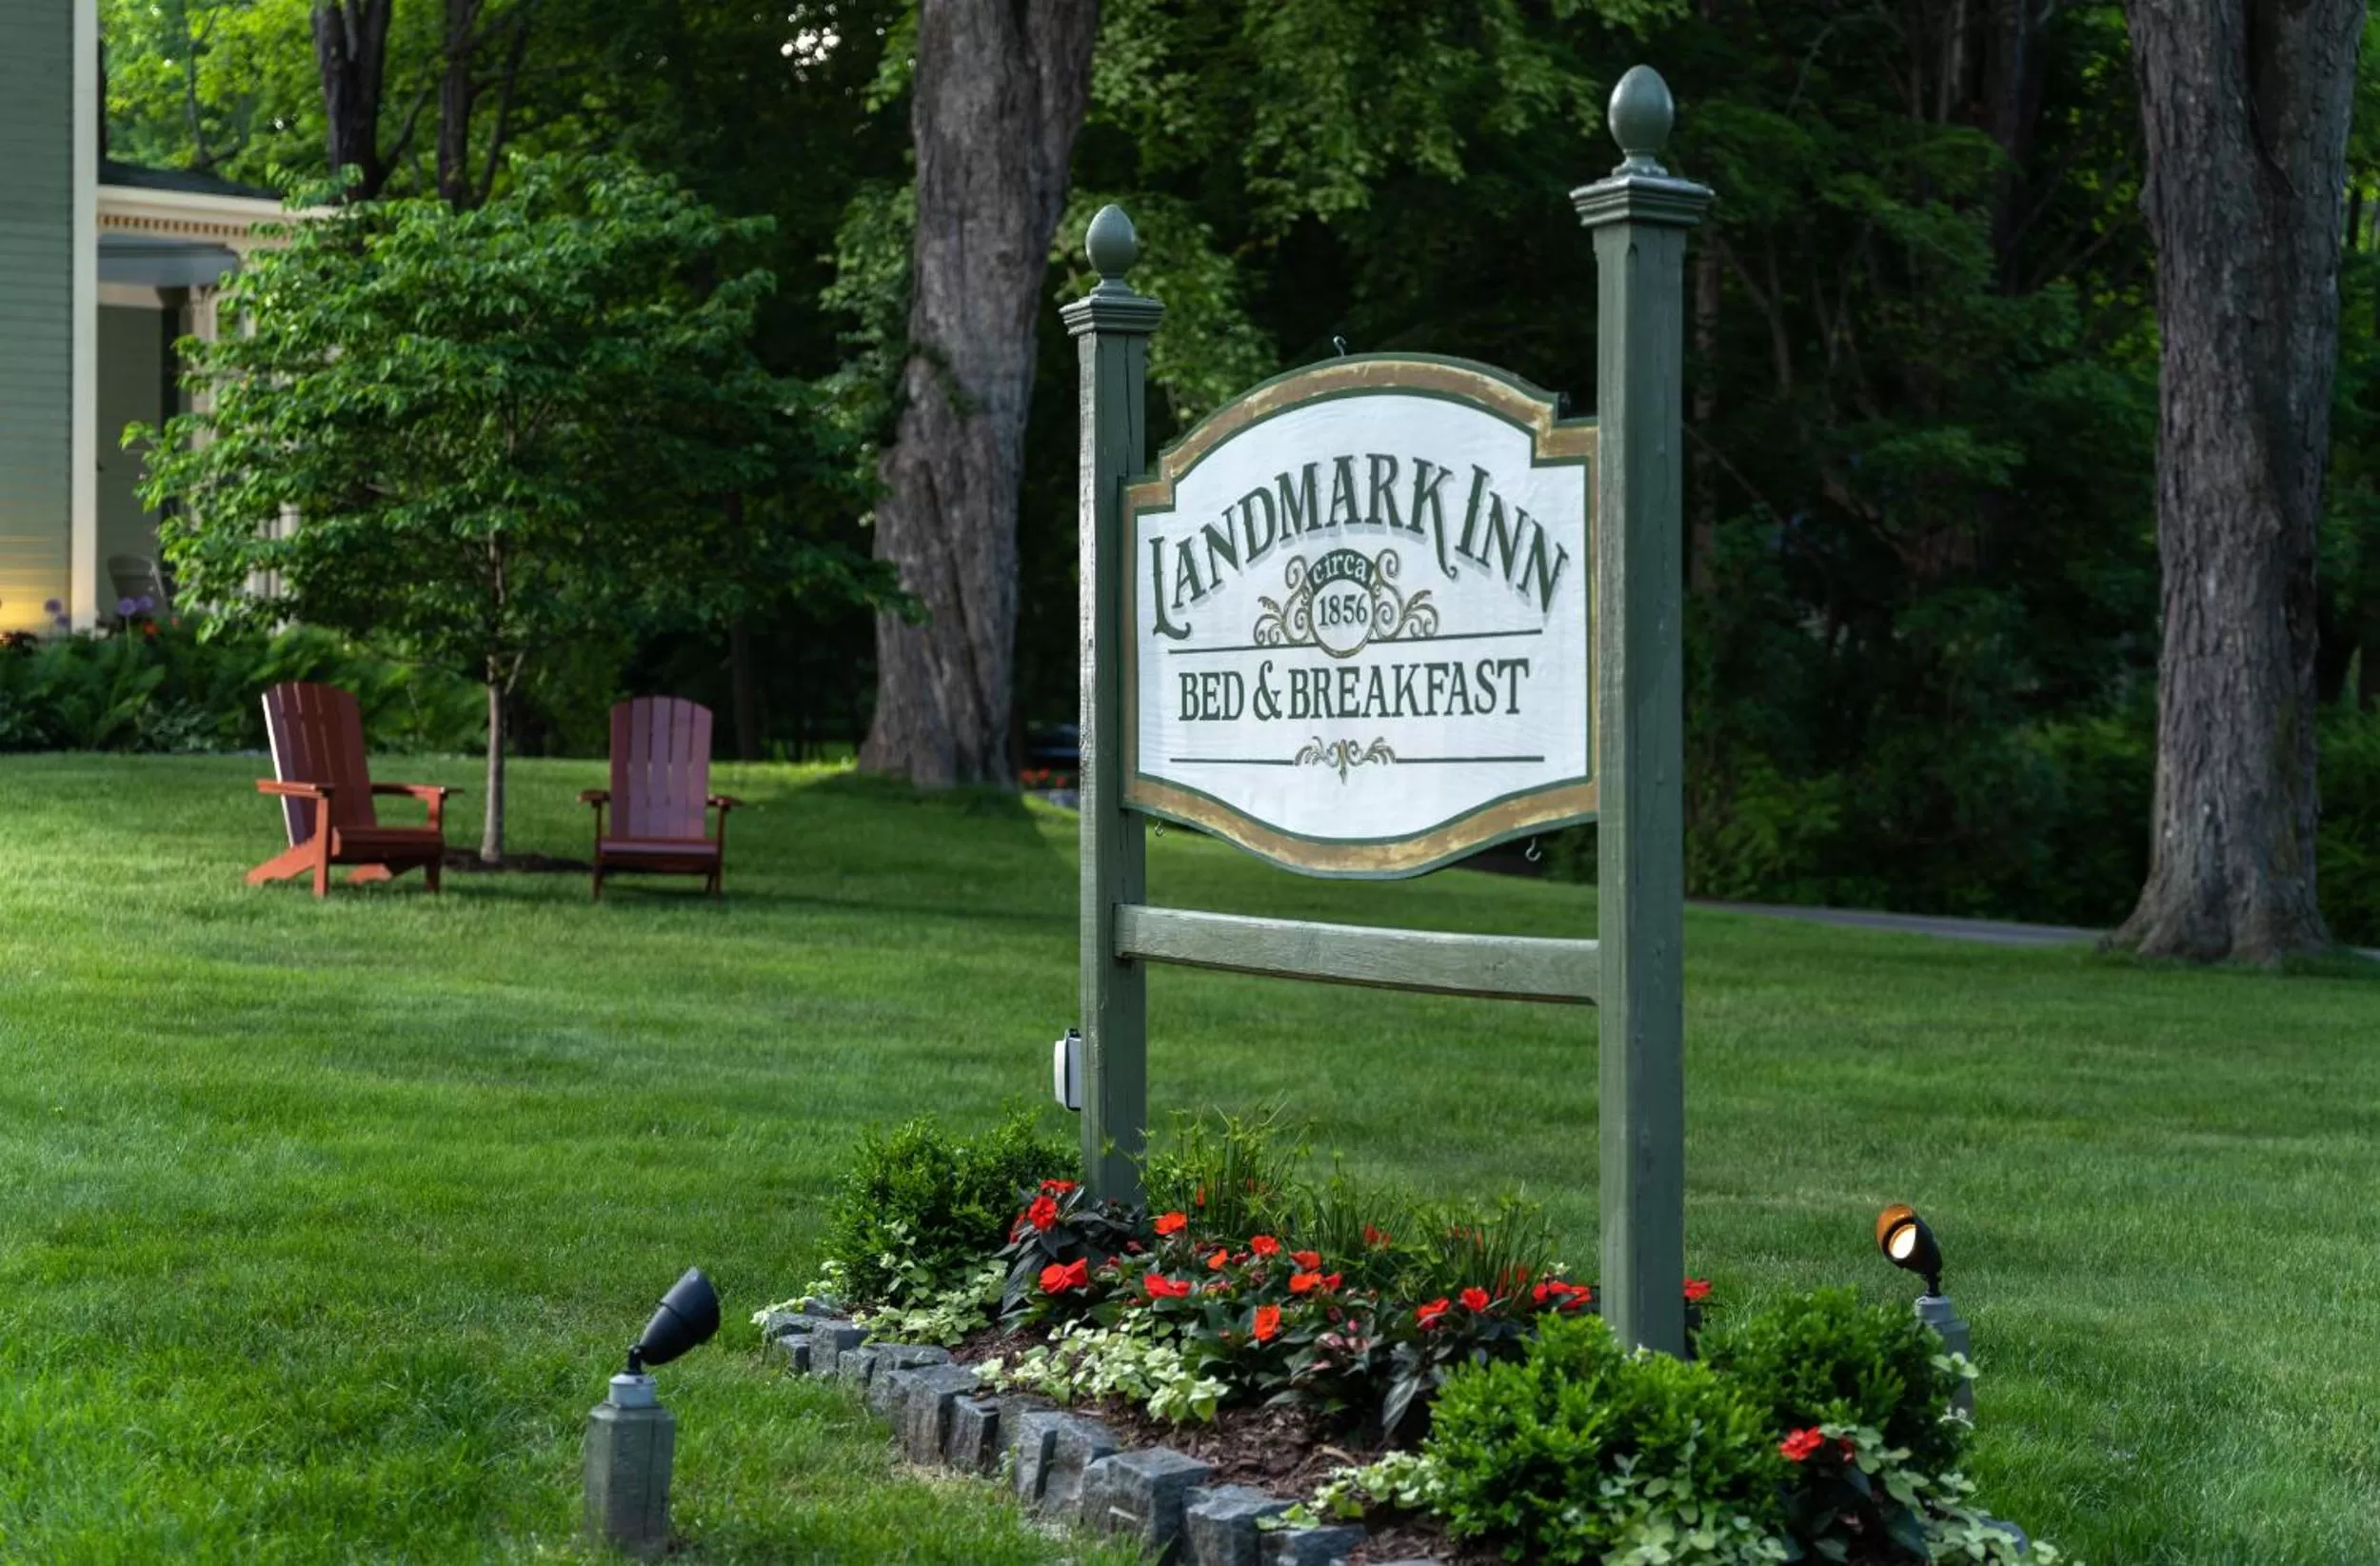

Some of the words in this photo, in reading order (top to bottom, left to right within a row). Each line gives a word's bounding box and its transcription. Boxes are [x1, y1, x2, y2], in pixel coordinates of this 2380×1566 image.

[1149, 453, 1458, 640] LANDMARK
[1455, 464, 1570, 614] INN
[1313, 553, 1368, 584] circa
[1318, 593, 1368, 626] 1856
[1179, 670, 1244, 722] BED
[1253, 661, 1282, 722] &
[1288, 658, 1530, 720] BREAKFAST
